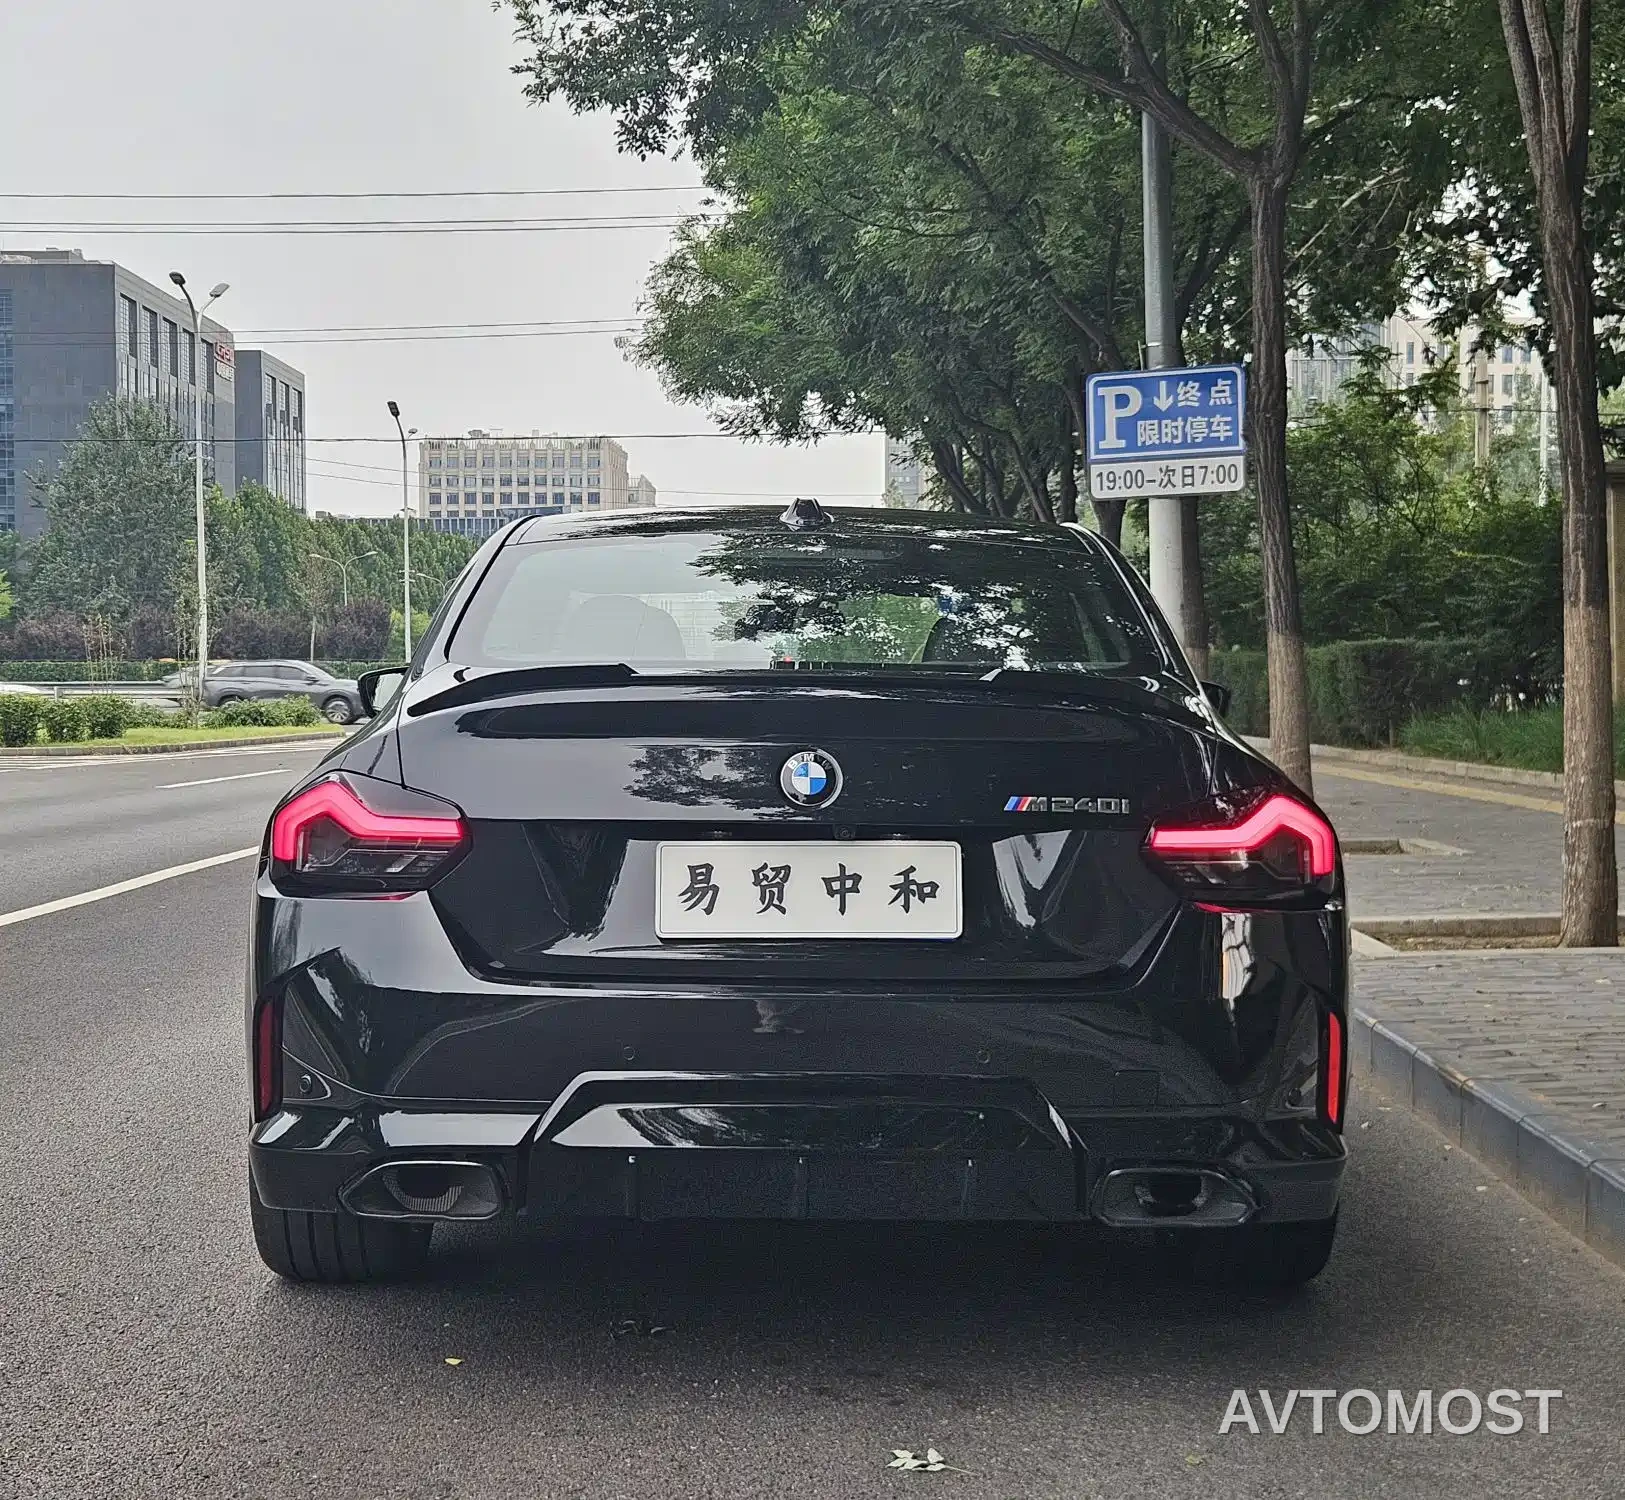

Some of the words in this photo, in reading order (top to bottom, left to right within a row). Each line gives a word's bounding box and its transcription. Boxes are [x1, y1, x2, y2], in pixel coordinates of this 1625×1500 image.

[1176, 378, 1233, 408] 终点
[1097, 385, 1143, 449] P
[1136, 414, 1234, 446] 限时停车
[787, 753, 833, 771] BMW
[677, 862, 941, 917] 易贸中和
